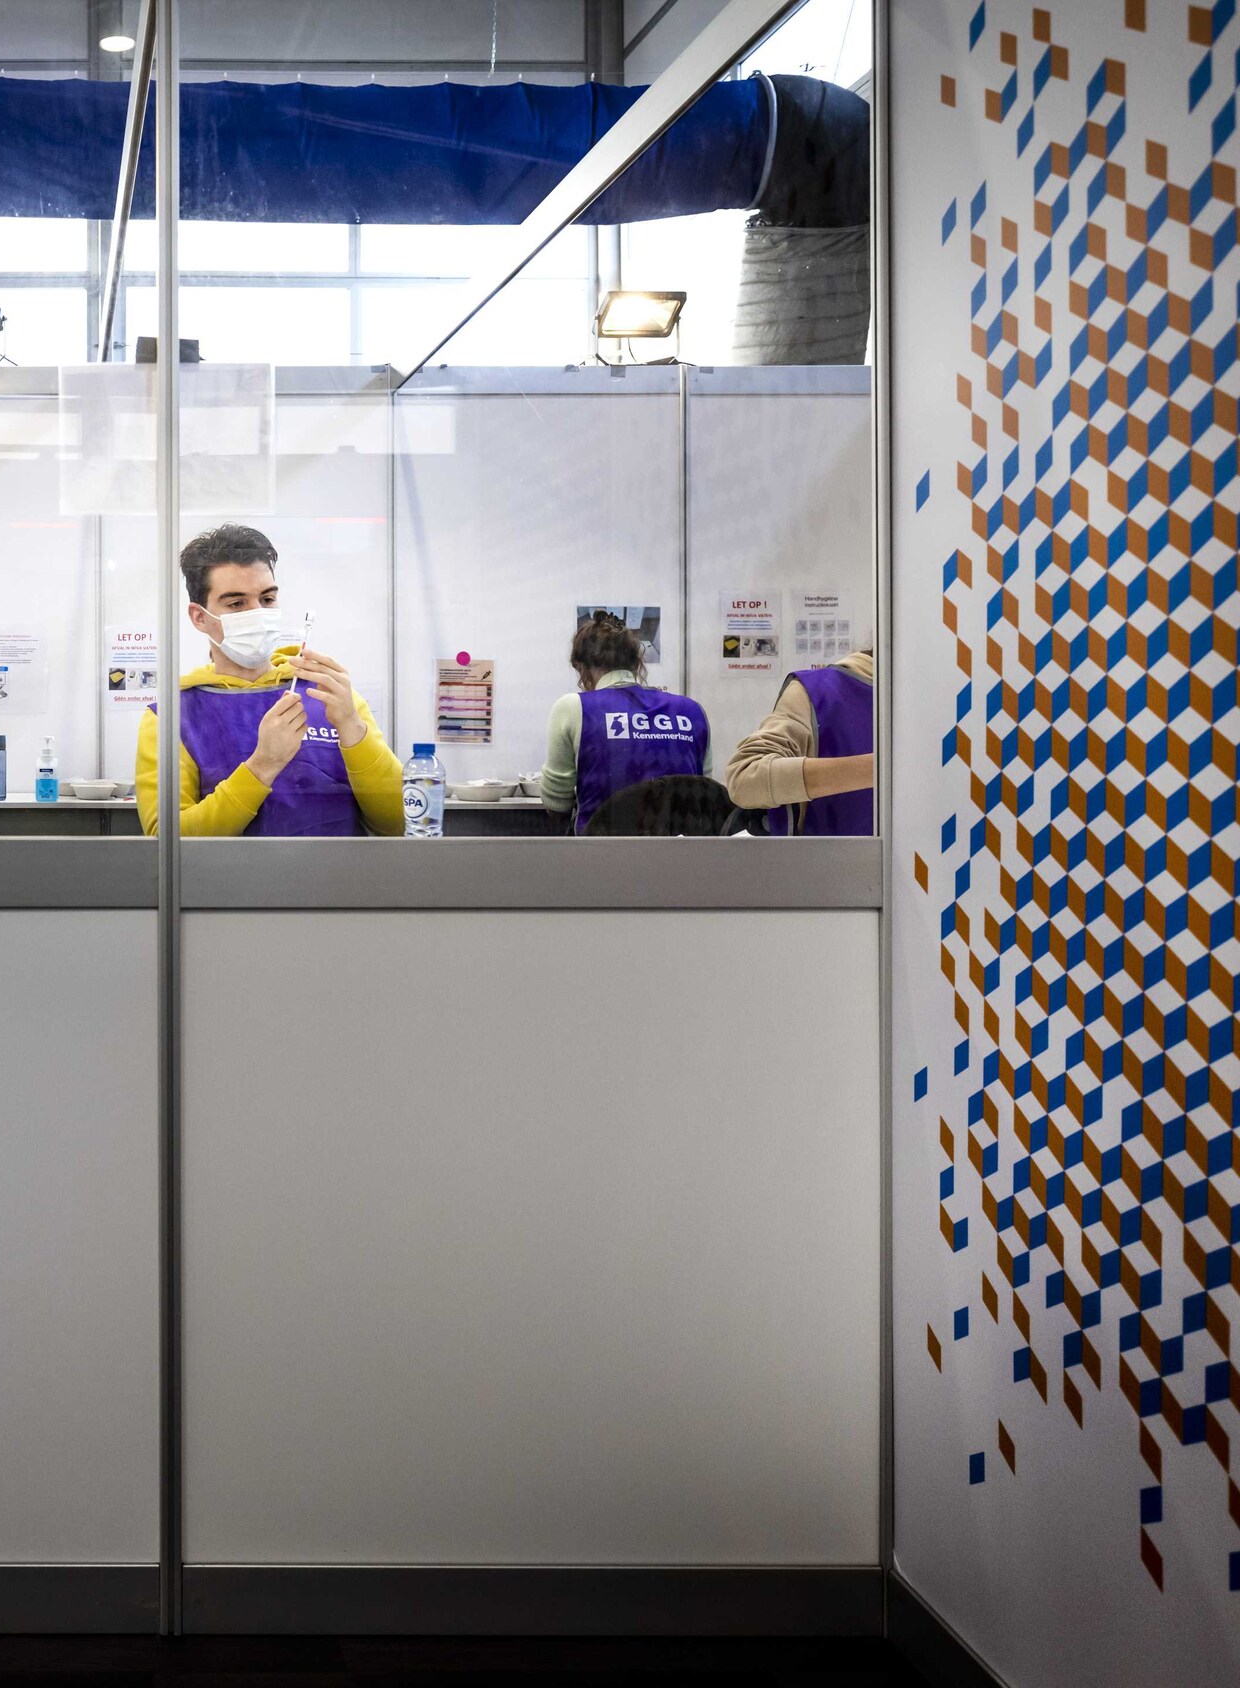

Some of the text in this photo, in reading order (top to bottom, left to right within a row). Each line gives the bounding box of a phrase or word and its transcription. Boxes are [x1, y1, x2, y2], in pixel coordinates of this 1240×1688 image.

[732, 601, 746, 609] LET
[749, 601, 761, 609] OP
[118, 633, 132, 641] LET
[134, 633, 146, 641] OP
[631, 713, 692, 732] GGD
[632, 732, 694, 742] Kennemerland
[404, 798, 423, 807] SPA
